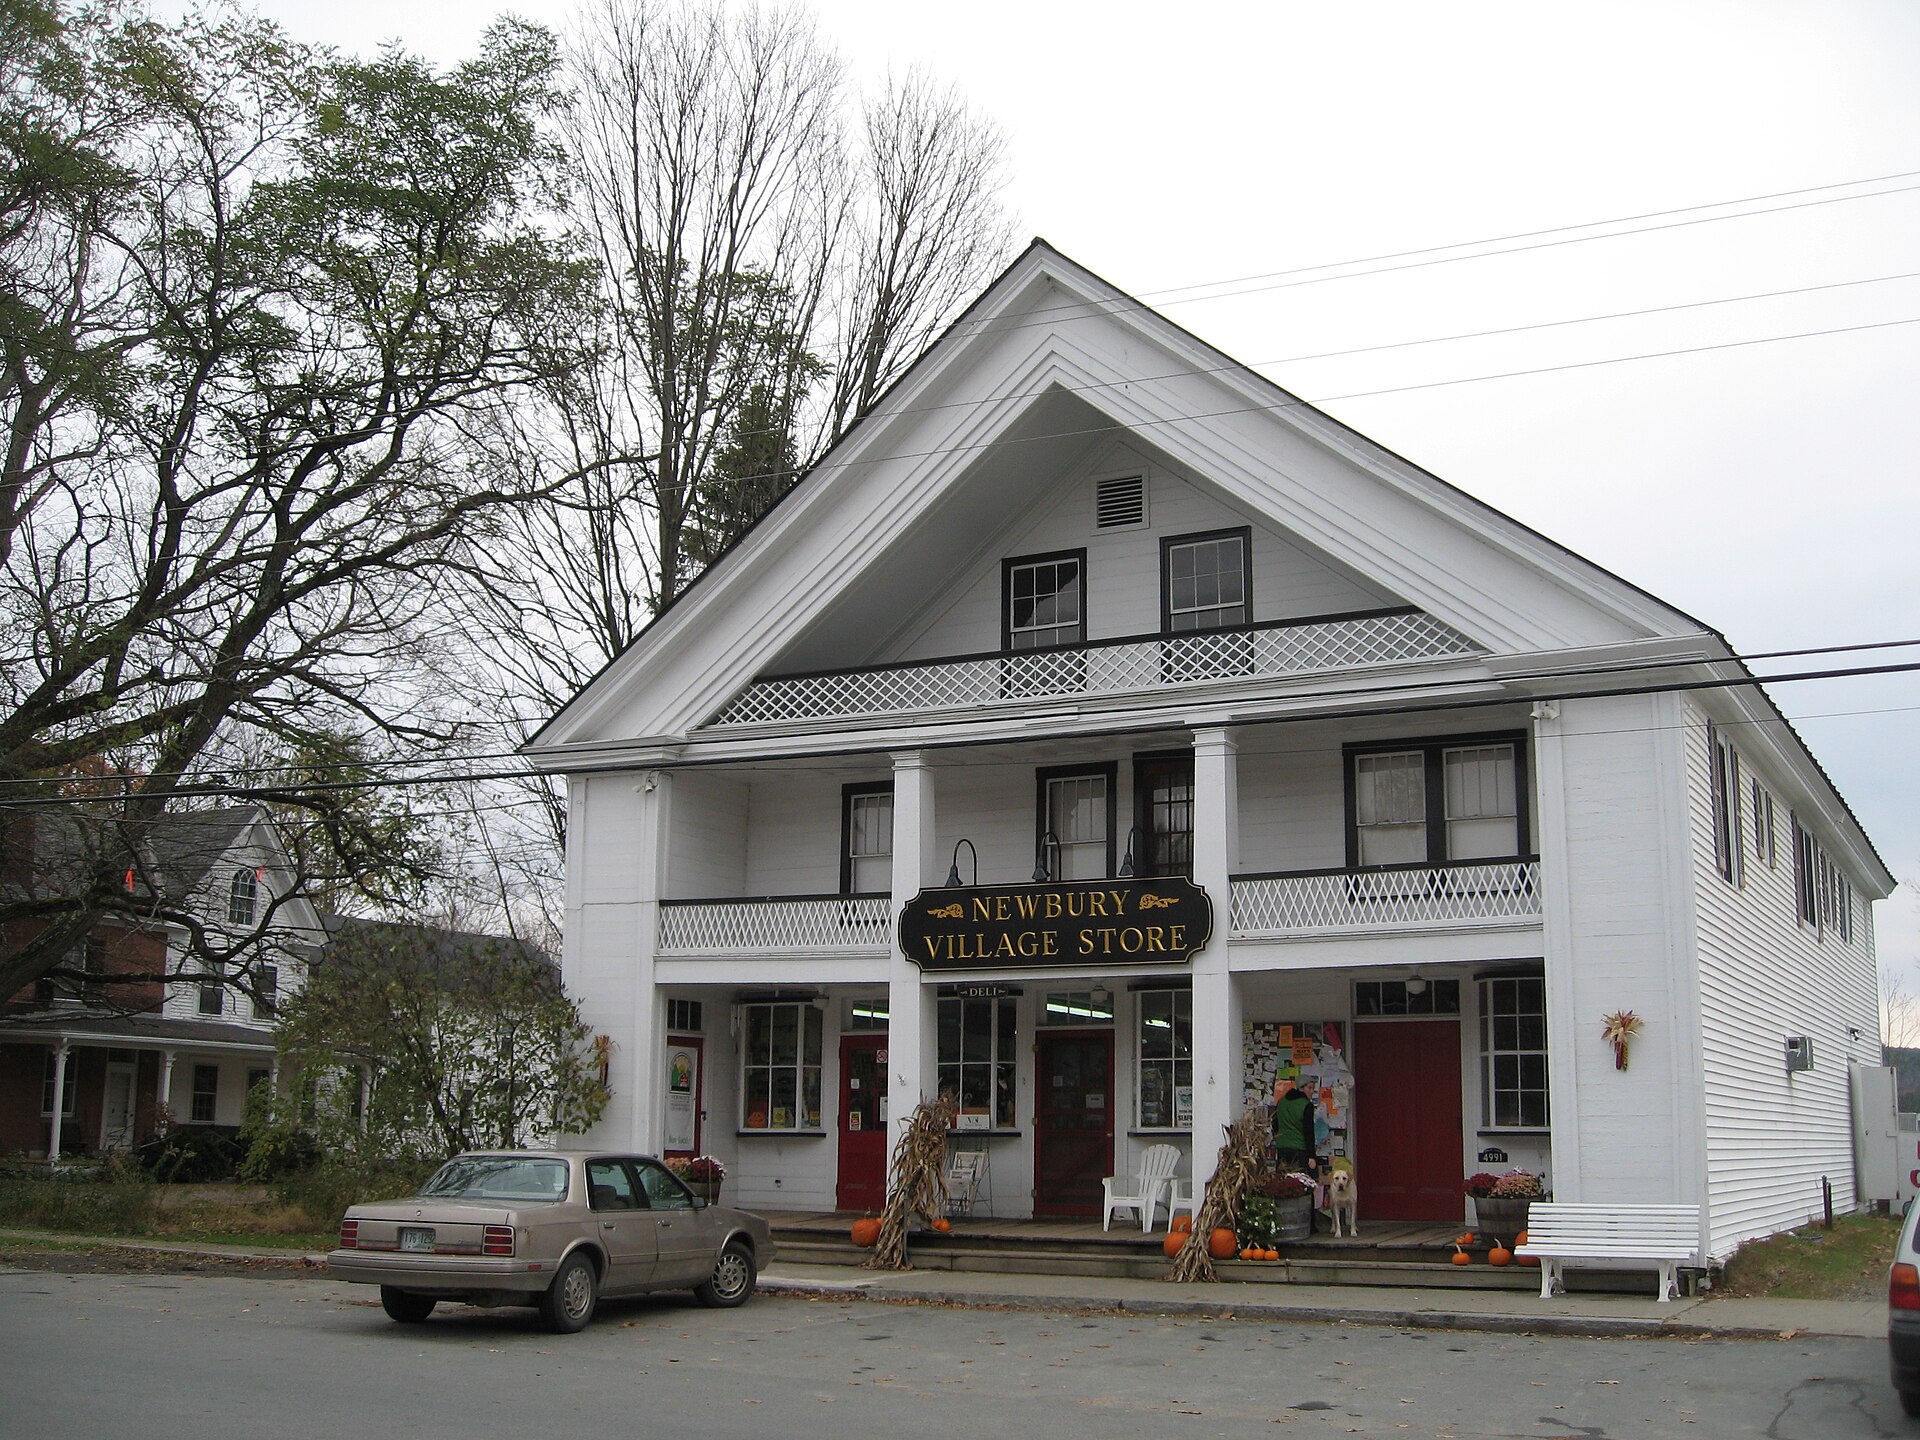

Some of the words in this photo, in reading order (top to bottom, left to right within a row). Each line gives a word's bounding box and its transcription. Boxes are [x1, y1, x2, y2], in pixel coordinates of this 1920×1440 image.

[972, 889, 1130, 922] NEWBURY
[923, 930, 1059, 960] VILLAGE
[1079, 925, 1188, 955] STORE
[969, 987, 997, 997] DELI
[1482, 1153, 1503, 1162] 4991
